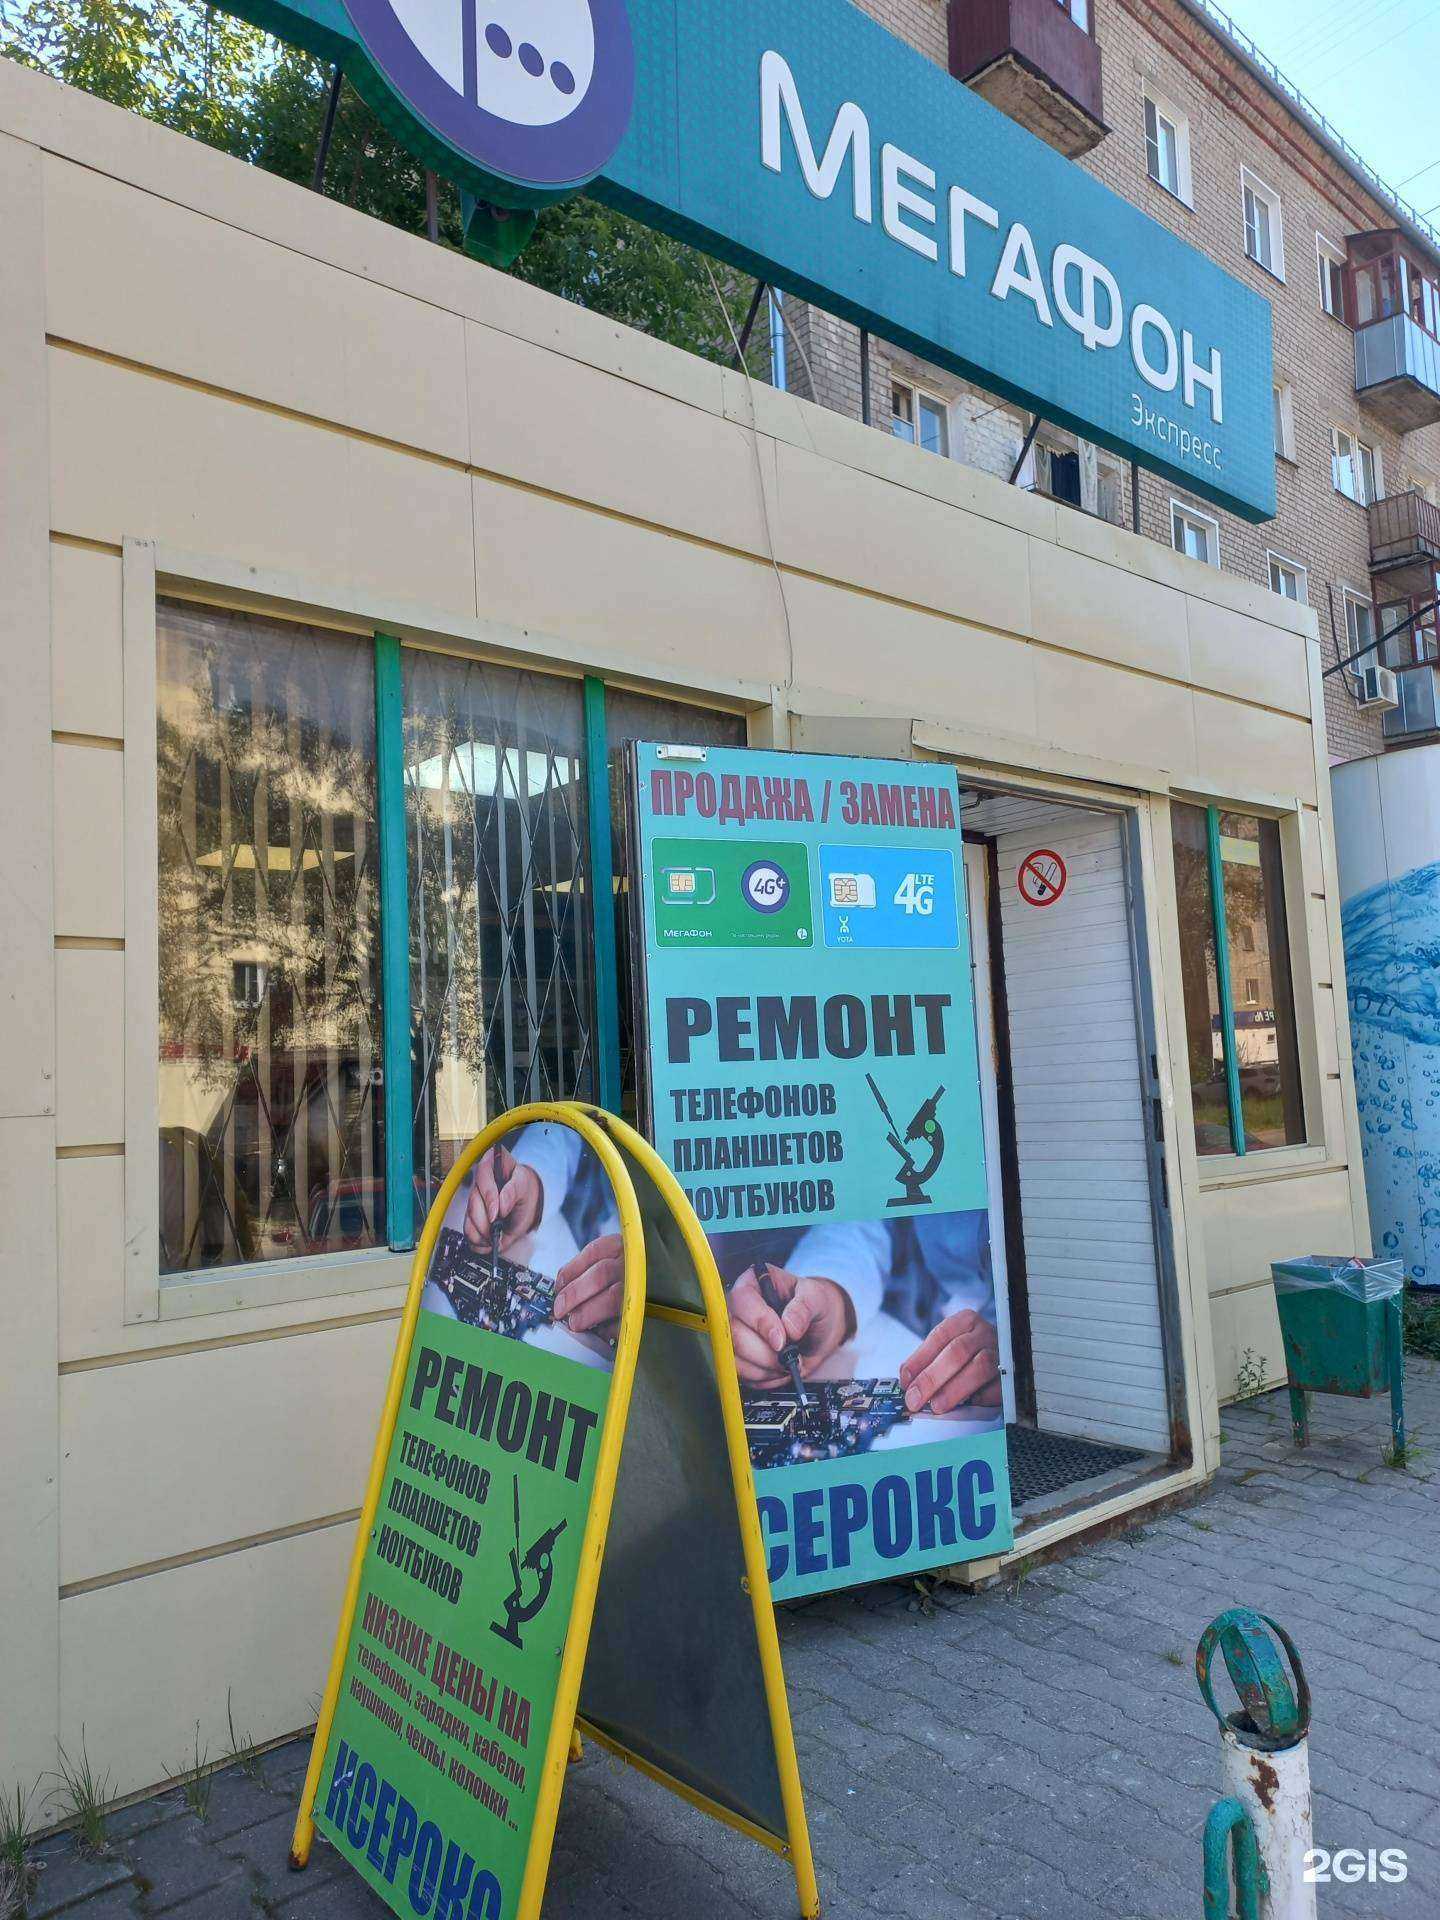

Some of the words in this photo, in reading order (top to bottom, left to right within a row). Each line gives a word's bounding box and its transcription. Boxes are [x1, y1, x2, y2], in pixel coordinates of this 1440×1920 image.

[760, 49, 1223, 424] МЕГАФОН
[1130, 393, 1223, 471] Экспресс
[650, 769, 815, 826] ПРОДАЖА
[839, 782, 957, 830] ЗАМЕНА
[893, 873, 935, 915] 4G
[915, 874, 935, 885] LTE
[836, 935, 854, 944] YOTA
[665, 994, 952, 1063] РЕМОНТ
[669, 1083, 837, 1122] ТЕЛЕФОНОВ
[673, 1130, 844, 1172] ПЛАНШЕТОВ
[409, 1346, 599, 1483] РЕМОНТ
[399, 1430, 491, 1505] ТЕЛЕФОНОВ
[387, 1477, 482, 1558] ПЛАНШЕТОВ
[756, 1459, 997, 1584] СЕРОКС
[376, 1524, 464, 1605] НОУТБУКОВ
[361, 1591, 433, 1676] НИЗКИЕ
[430, 1641, 498, 1723] ЦЕНЫ
[497, 1684, 532, 1750] НА
[349, 1675, 404, 1741] наушники,
[405, 1723, 446, 1776] чехлы,
[414, 1690, 470, 1751] зарядки,
[471, 1732, 527, 1794] кабели,
